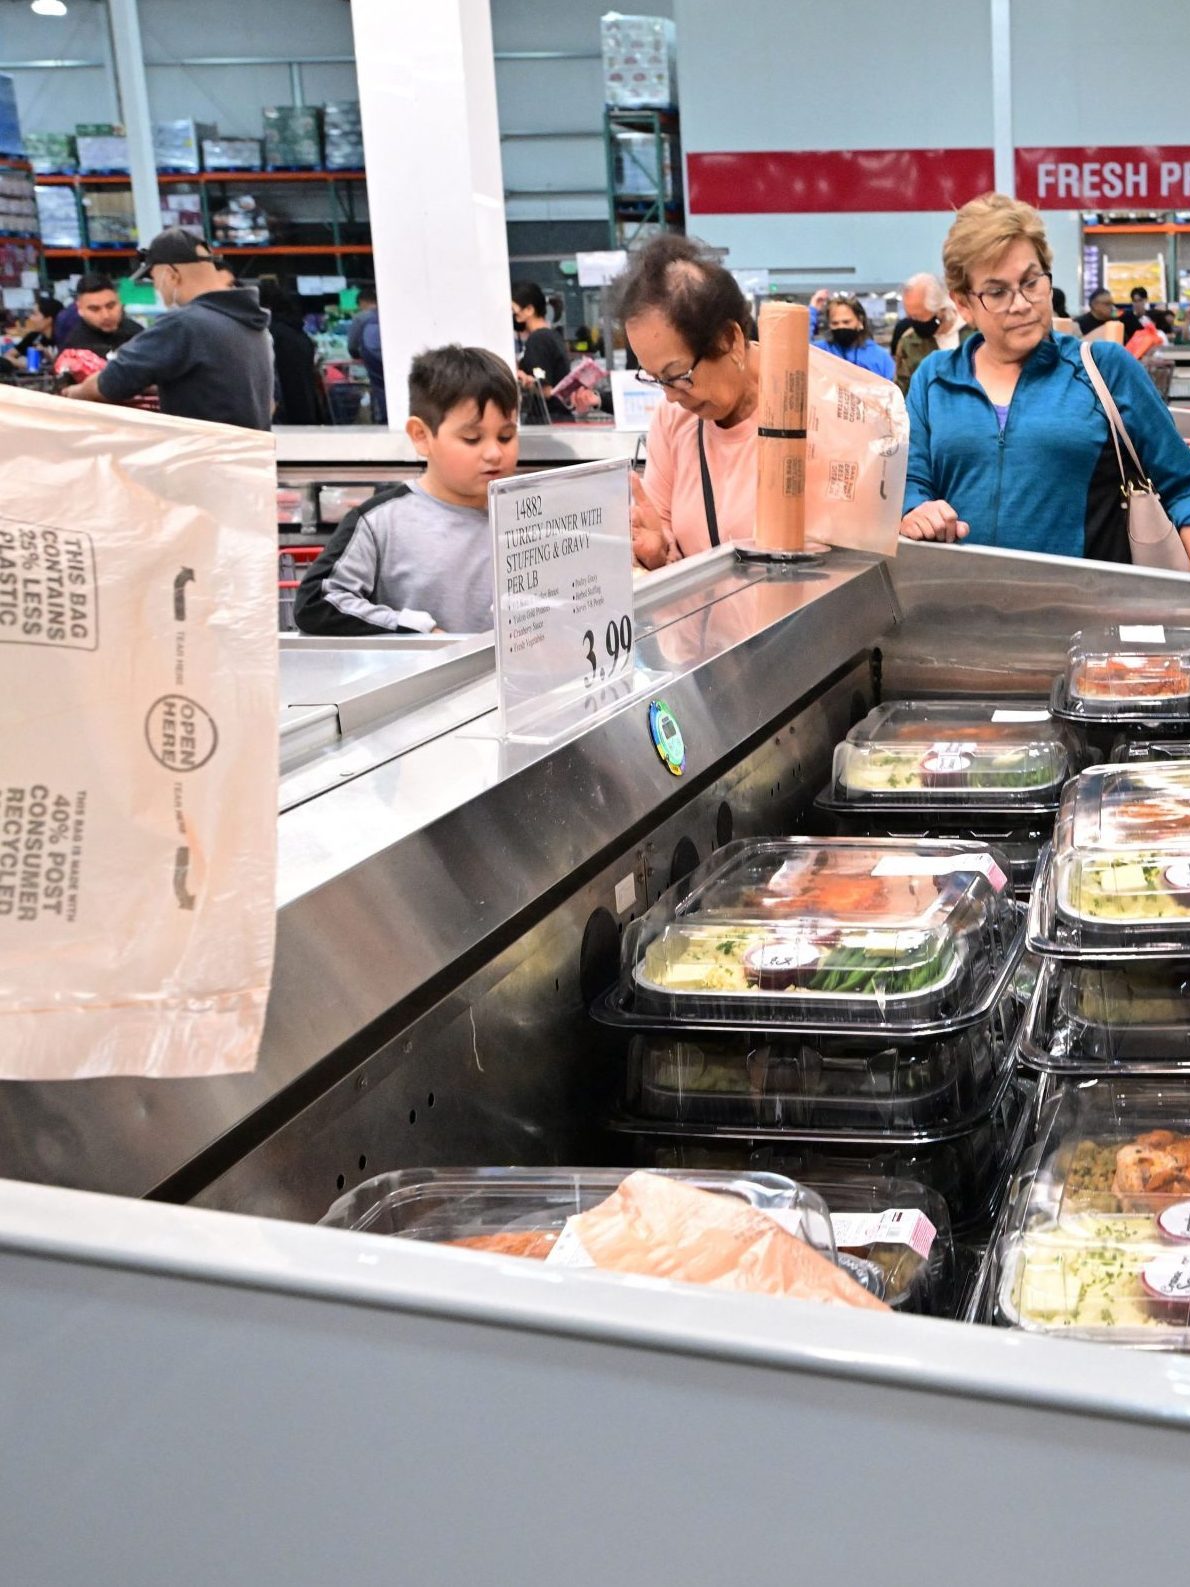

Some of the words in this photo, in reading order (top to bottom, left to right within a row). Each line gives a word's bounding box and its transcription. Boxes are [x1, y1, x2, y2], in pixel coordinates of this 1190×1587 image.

[1037, 162, 1148, 198] FRESH
[504, 521, 546, 550] TURKEY
[545, 513, 578, 538] DINNER
[580, 507, 602, 527] WITH
[515, 495, 543, 521] 14882
[19, 529, 40, 570] 25%
[64, 539, 86, 585] THIS
[506, 543, 551, 574] STUFFING
[552, 545, 560, 559] &
[561, 533, 590, 556] GRAVY
[0, 531, 18, 626] PLASTIC
[41, 530, 65, 641] CONTAINS
[507, 575, 525, 597] PER
[527, 570, 539, 589] LB
[22, 578, 42, 635] LESS
[69, 592, 88, 639] BAG
[583, 614, 632, 688] 3.99
[162, 701, 176, 764] HERE
[179, 704, 195, 767] OPEN
[48, 794, 71, 844] 40%
[0, 787, 25, 915] RECYCLED
[18, 784, 49, 921] CONSUMER
[42, 851, 66, 915] POST
